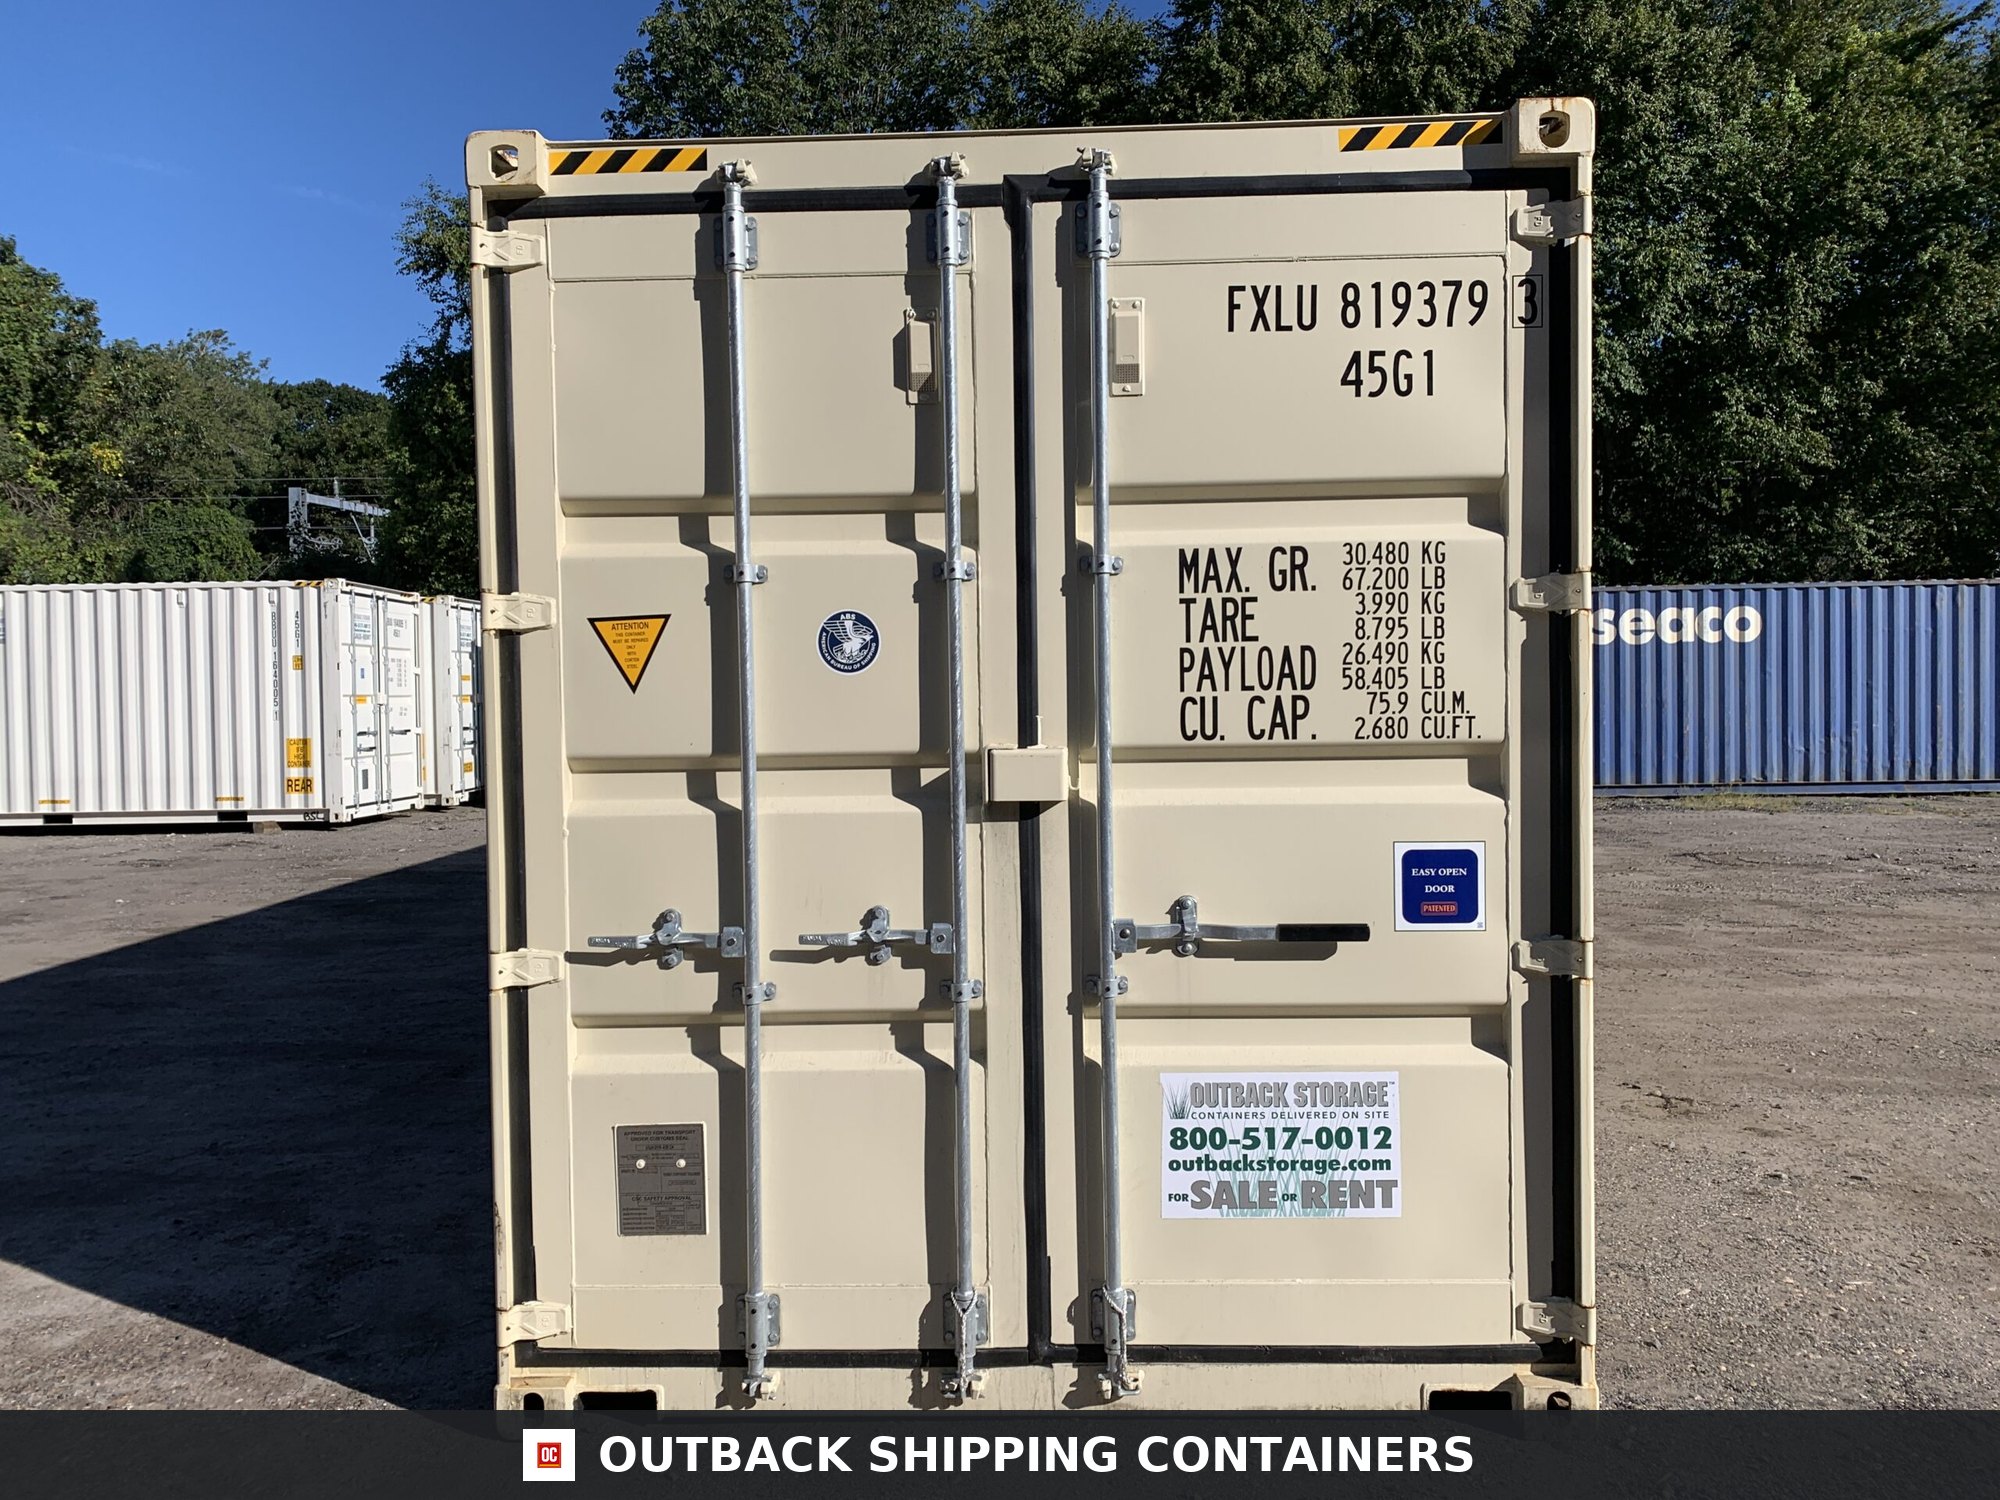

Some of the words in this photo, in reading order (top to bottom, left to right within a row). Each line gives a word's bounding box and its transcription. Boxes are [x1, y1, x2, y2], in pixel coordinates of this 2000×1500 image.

[1227, 285, 1317, 332] FXLU
[1340, 280, 1488, 328] 819379
[1517, 278, 1538, 326] 3
[1340, 350, 1434, 398] 45G1
[1342, 542, 1408, 566] 30,480
[1421, 541, 1445, 564] KG
[1179, 547, 1250, 593] MAX.
[1269, 546, 1317, 591] GR.
[1342, 567, 1408, 591] 67,200
[1421, 566, 1445, 590] LB
[1354, 592, 1408, 616] 3,990
[1421, 591, 1445, 615] KG
[612, 622, 649, 630] ATTENTION
[1179, 597, 1259, 643] TARE
[1354, 616, 1408, 641] 8,795
[1421, 616, 1445, 639] LB
[1592, 605, 1763, 646] seaco
[1342, 642, 1408, 666] 26,490
[1421, 641, 1445, 665] KG
[1179, 645, 1316, 692] PAYLOAD
[1342, 667, 1408, 691] 58,405
[1421, 666, 1445, 689] LB
[1366, 691, 1409, 715] 75.9
[1421, 691, 1470, 714] CU.M.
[1180, 696, 1225, 741] CU.
[1247, 695, 1317, 741] CAP.
[1354, 716, 1408, 740] 2,680
[1421, 716, 1482, 739] CU.FT.
[287, 778, 313, 792] REAR
[1411, 868, 1437, 876] EASY
[1438, 867, 1467, 876] OPEN
[1425, 884, 1455, 893] DOOR
[1423, 904, 1456, 912] PATENTED
[1190, 1082, 1290, 1108] OUTBACK
[1293, 1081, 1389, 1108] STORAGE
[1191, 1111, 1266, 1119] CONTAINERS
[1271, 1111, 1337, 1119] DELIVERED
[1342, 1111, 1359, 1119] ON
[1364, 1111, 1390, 1119] SITE
[1169, 1126, 1392, 1150] 800-517-0012
[1168, 1154, 1392, 1174] outbackstorage.com
[1168, 1193, 1189, 1202] FOR
[1190, 1179, 1277, 1210] SALE
[1282, 1193, 1297, 1202] OR
[1301, 1180, 1398, 1209] RENT
